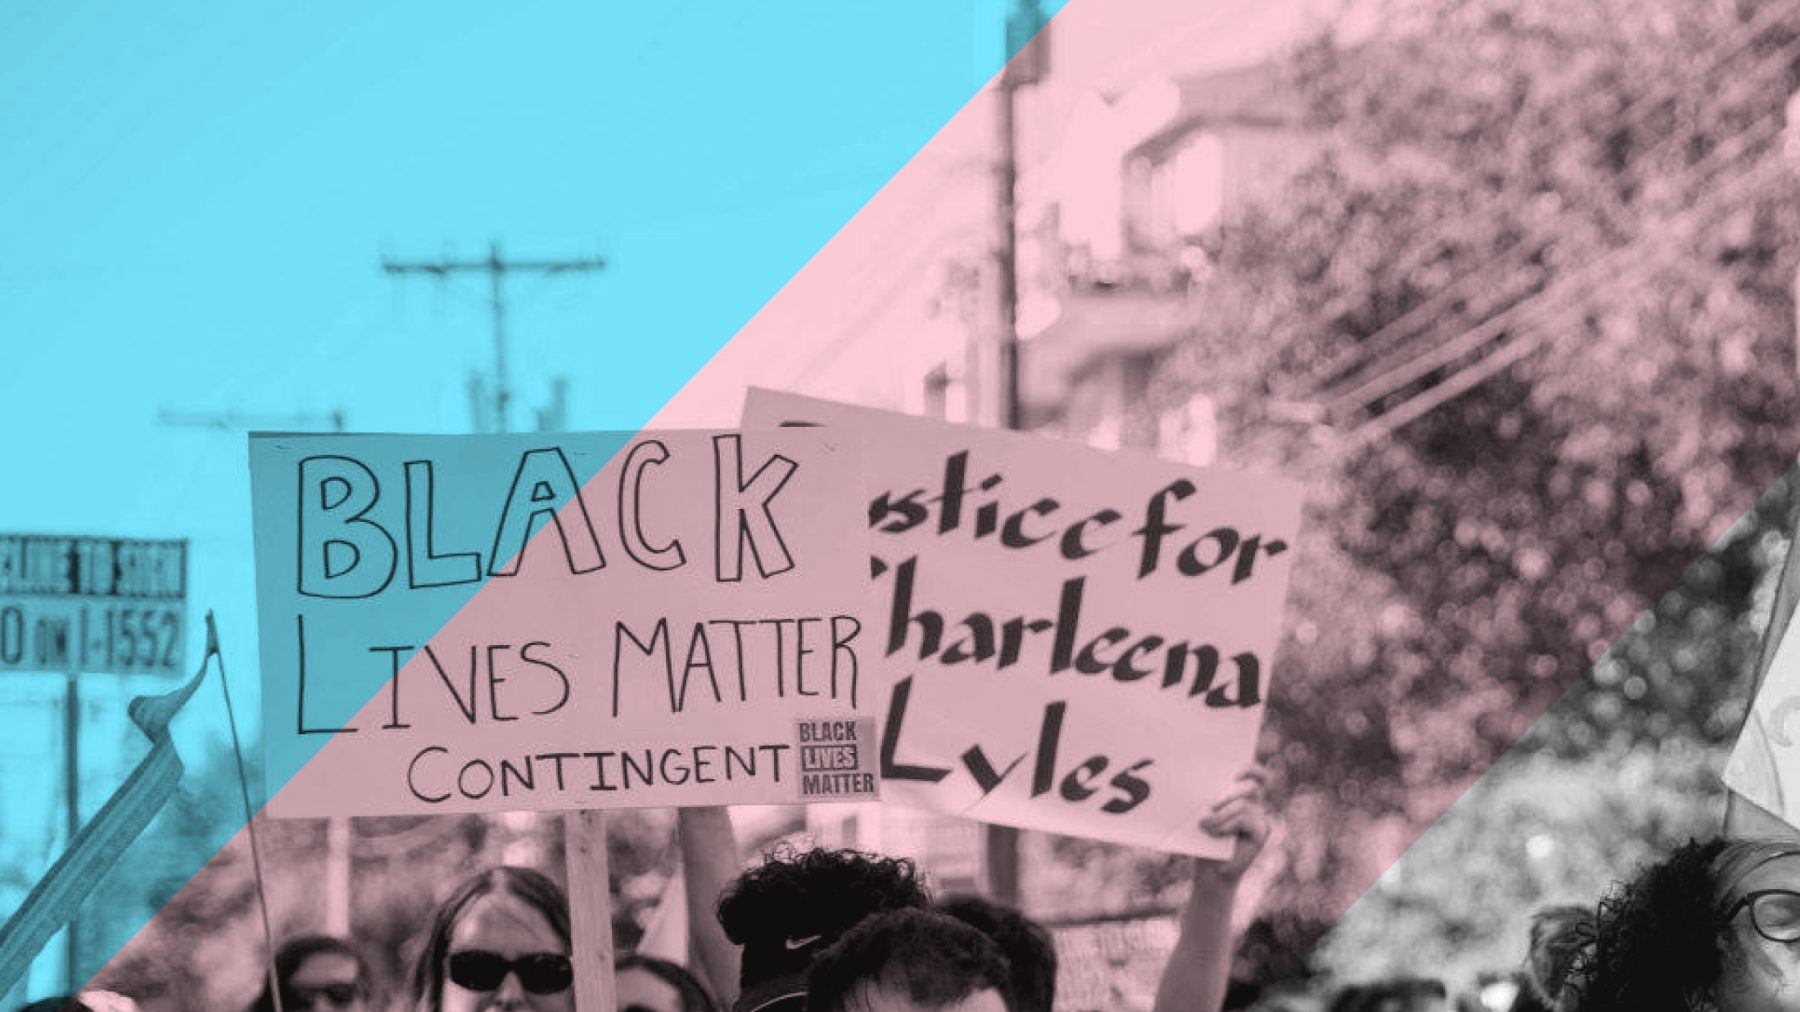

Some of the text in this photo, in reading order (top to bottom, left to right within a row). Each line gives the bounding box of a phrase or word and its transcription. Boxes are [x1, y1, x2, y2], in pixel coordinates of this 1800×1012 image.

[296, 433, 800, 600] BLACK
[868, 449, 1290, 587] stice for
[297, 614, 862, 735] LIVES MATTER
[870, 554, 1263, 709] harleena
[407, 744, 790, 803] CONTINGENT
[799, 720, 857, 742] BLACK
[803, 772, 875, 795] MATTER
[804, 747, 856, 769] LIVES
[880, 674, 1156, 814] Lyles
